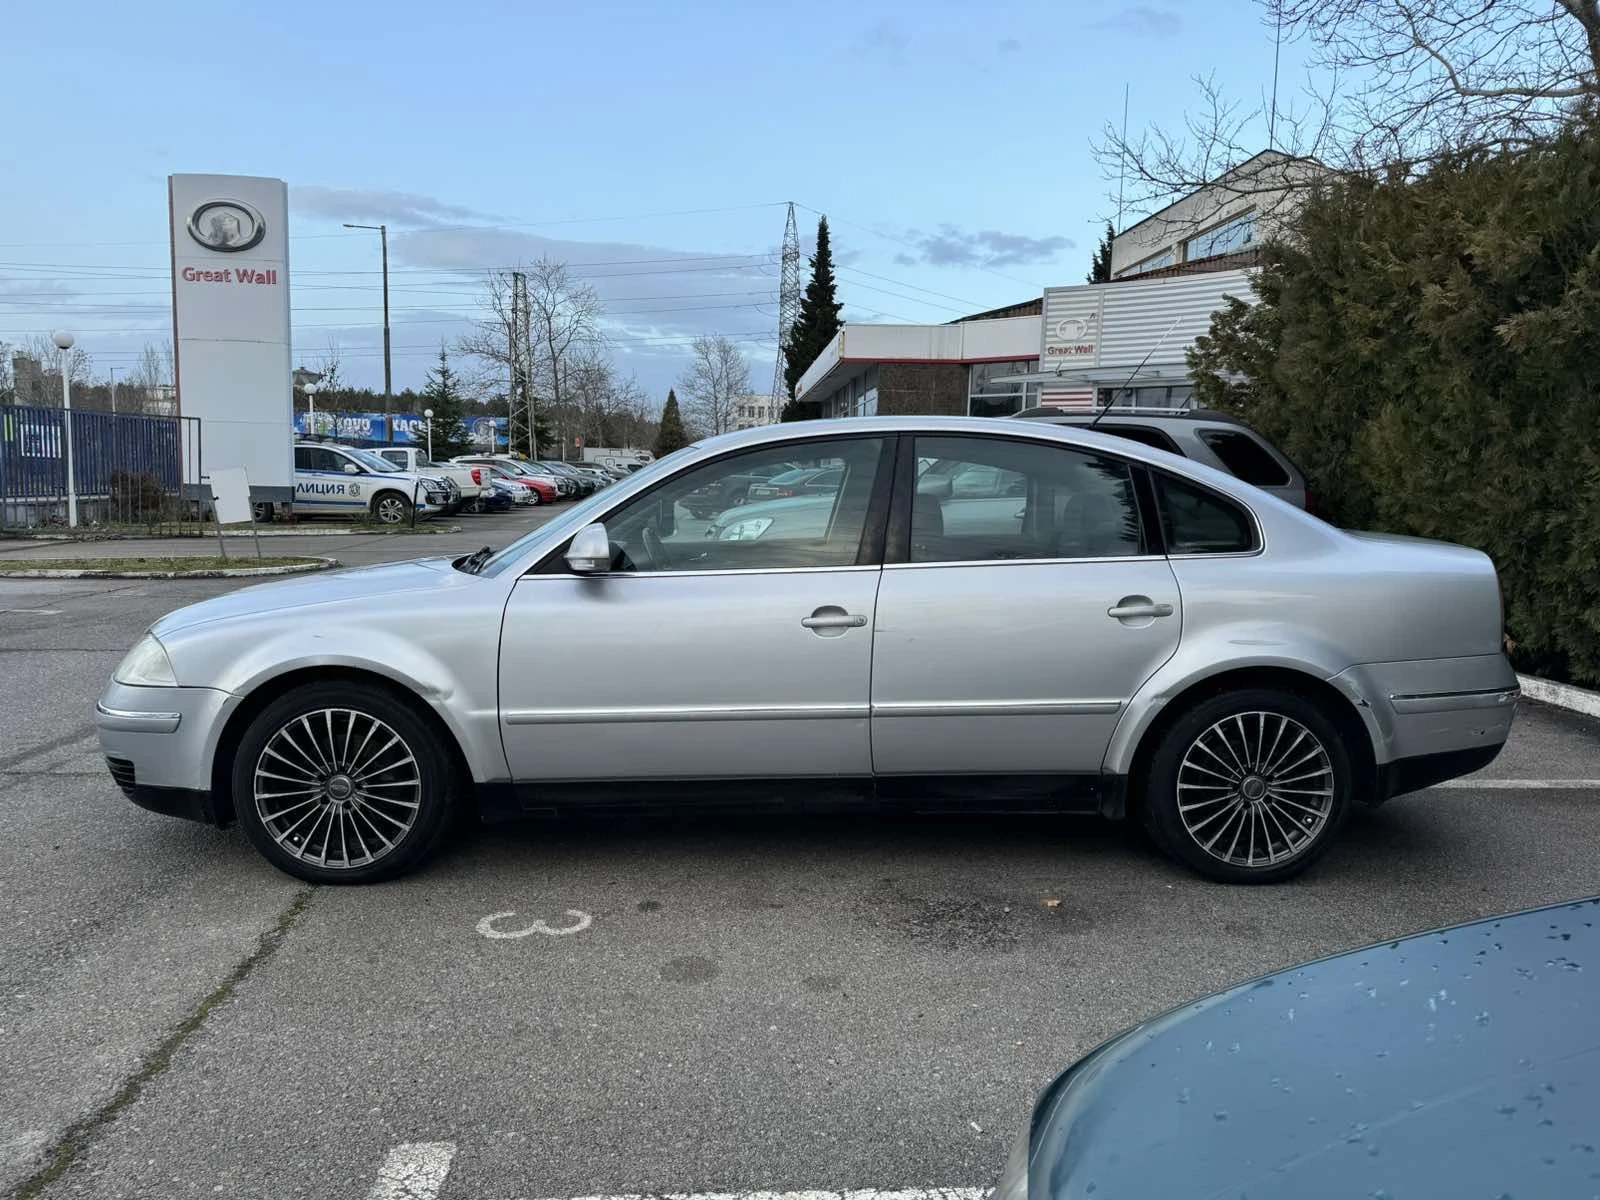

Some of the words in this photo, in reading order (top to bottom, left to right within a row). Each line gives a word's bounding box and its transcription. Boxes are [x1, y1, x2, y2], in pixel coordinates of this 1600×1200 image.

[182, 267, 231, 282] Great
[235, 268, 277, 285] Wall
[1047, 346, 1073, 355] Great
[1074, 344, 1093, 354] Wall
[296, 483, 345, 495] ЛИЦИЯ
